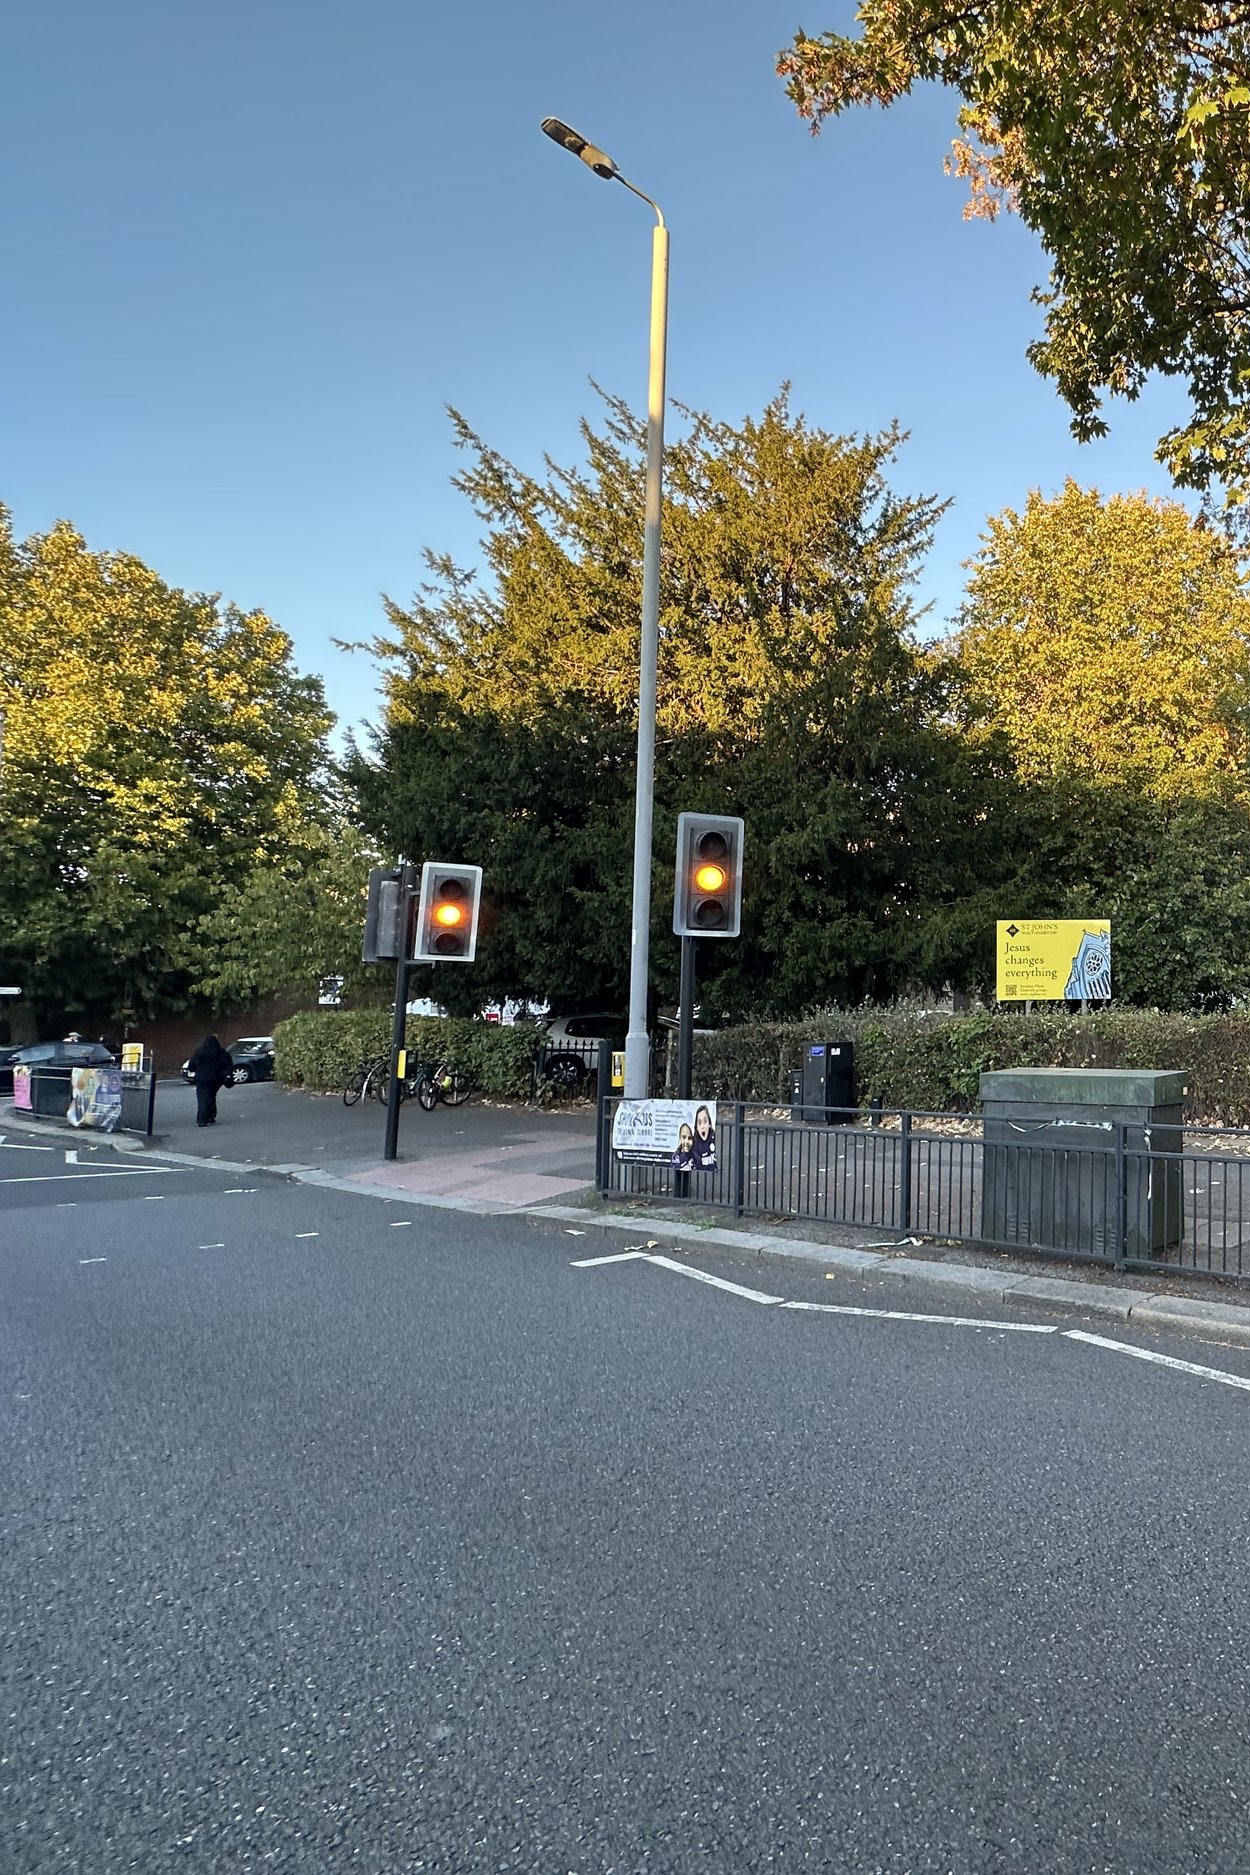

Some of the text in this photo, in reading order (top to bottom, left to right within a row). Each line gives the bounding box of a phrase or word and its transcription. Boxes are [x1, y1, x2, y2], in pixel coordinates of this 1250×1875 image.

[1004, 942, 1031, 954] Jesus
[1005, 955, 1044, 967] changes
[1005, 967, 1058, 980] everything
